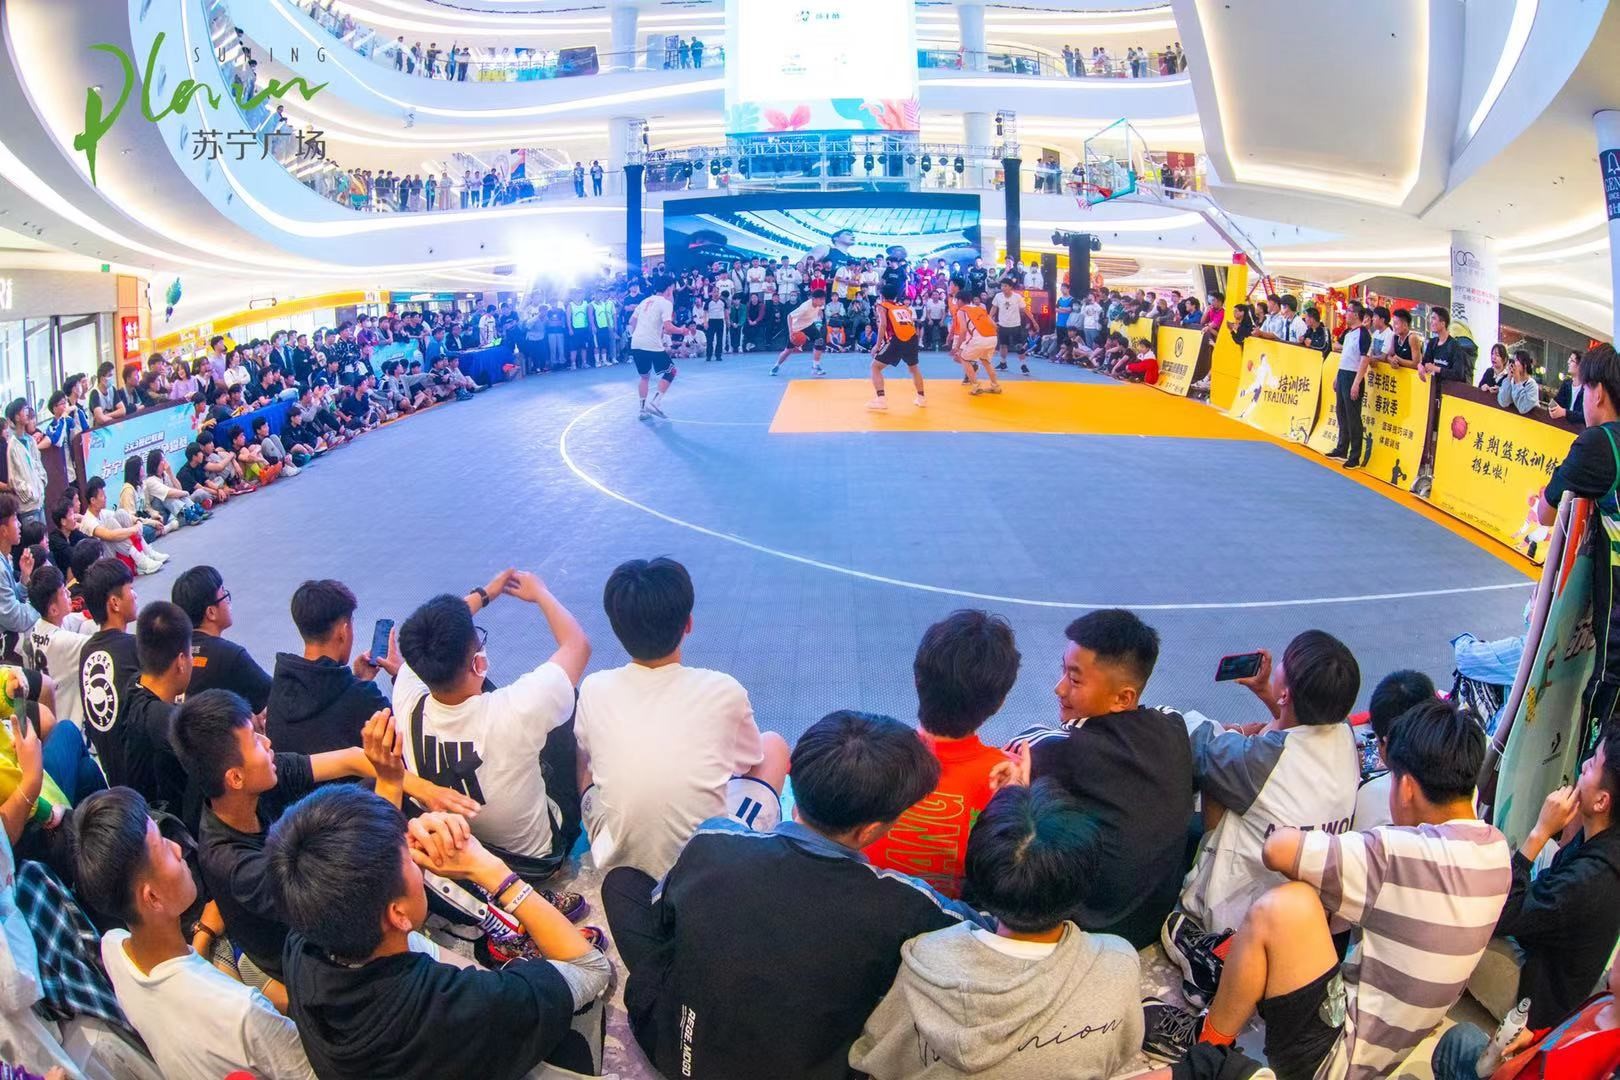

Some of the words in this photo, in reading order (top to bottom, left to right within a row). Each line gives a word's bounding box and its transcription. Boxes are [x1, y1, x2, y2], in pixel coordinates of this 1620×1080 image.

[1278, 374, 1311, 393] 培训班
[1263, 390, 1299, 406] TRAINING
